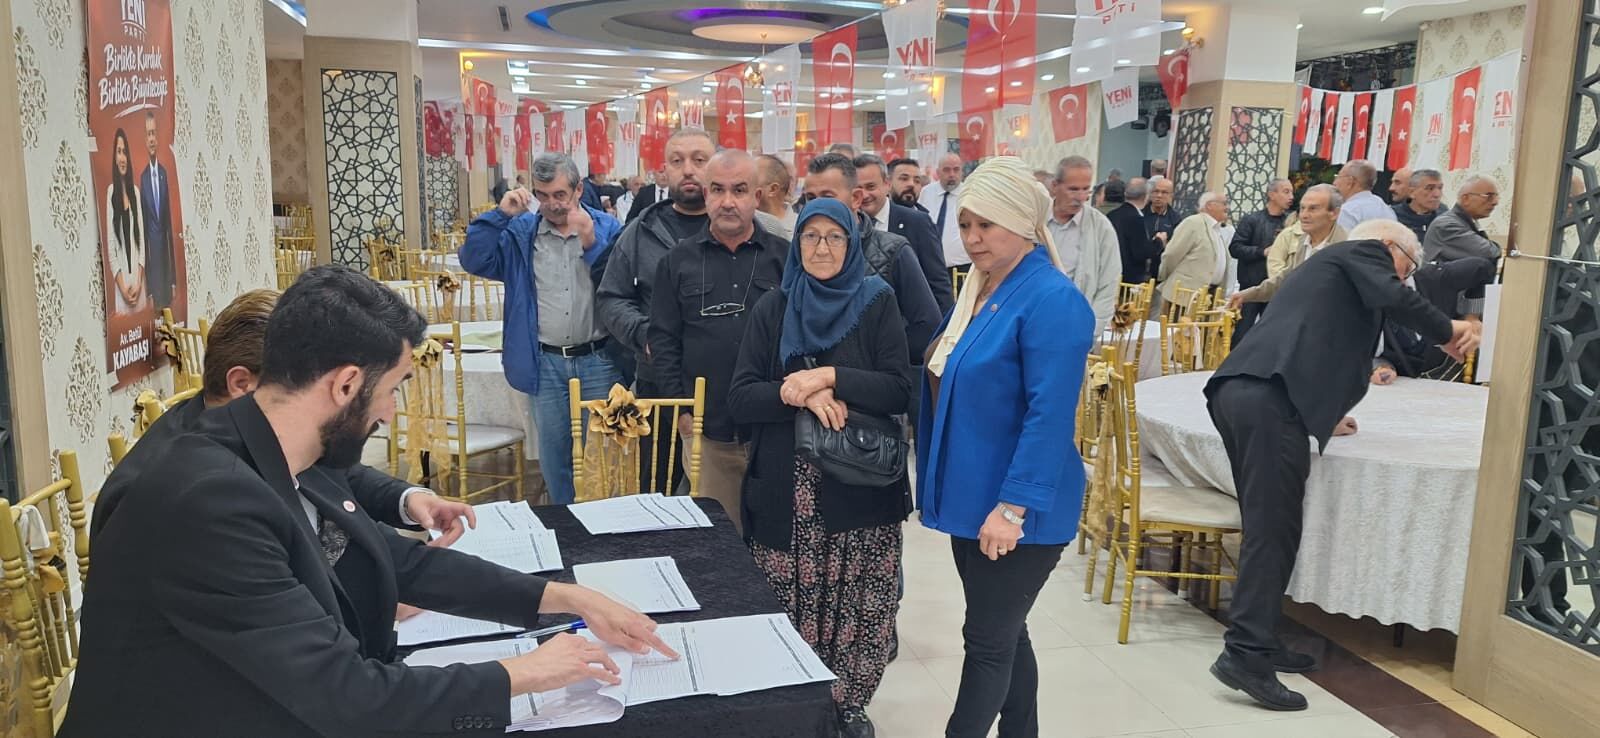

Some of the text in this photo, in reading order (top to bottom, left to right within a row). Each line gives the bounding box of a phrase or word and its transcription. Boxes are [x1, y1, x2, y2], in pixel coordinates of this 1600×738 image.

[103, 43, 163, 76] Birlikte Kurduk
[98, 77, 131, 110] Birlikte
[112, 338, 149, 371] KAYABAŞI
